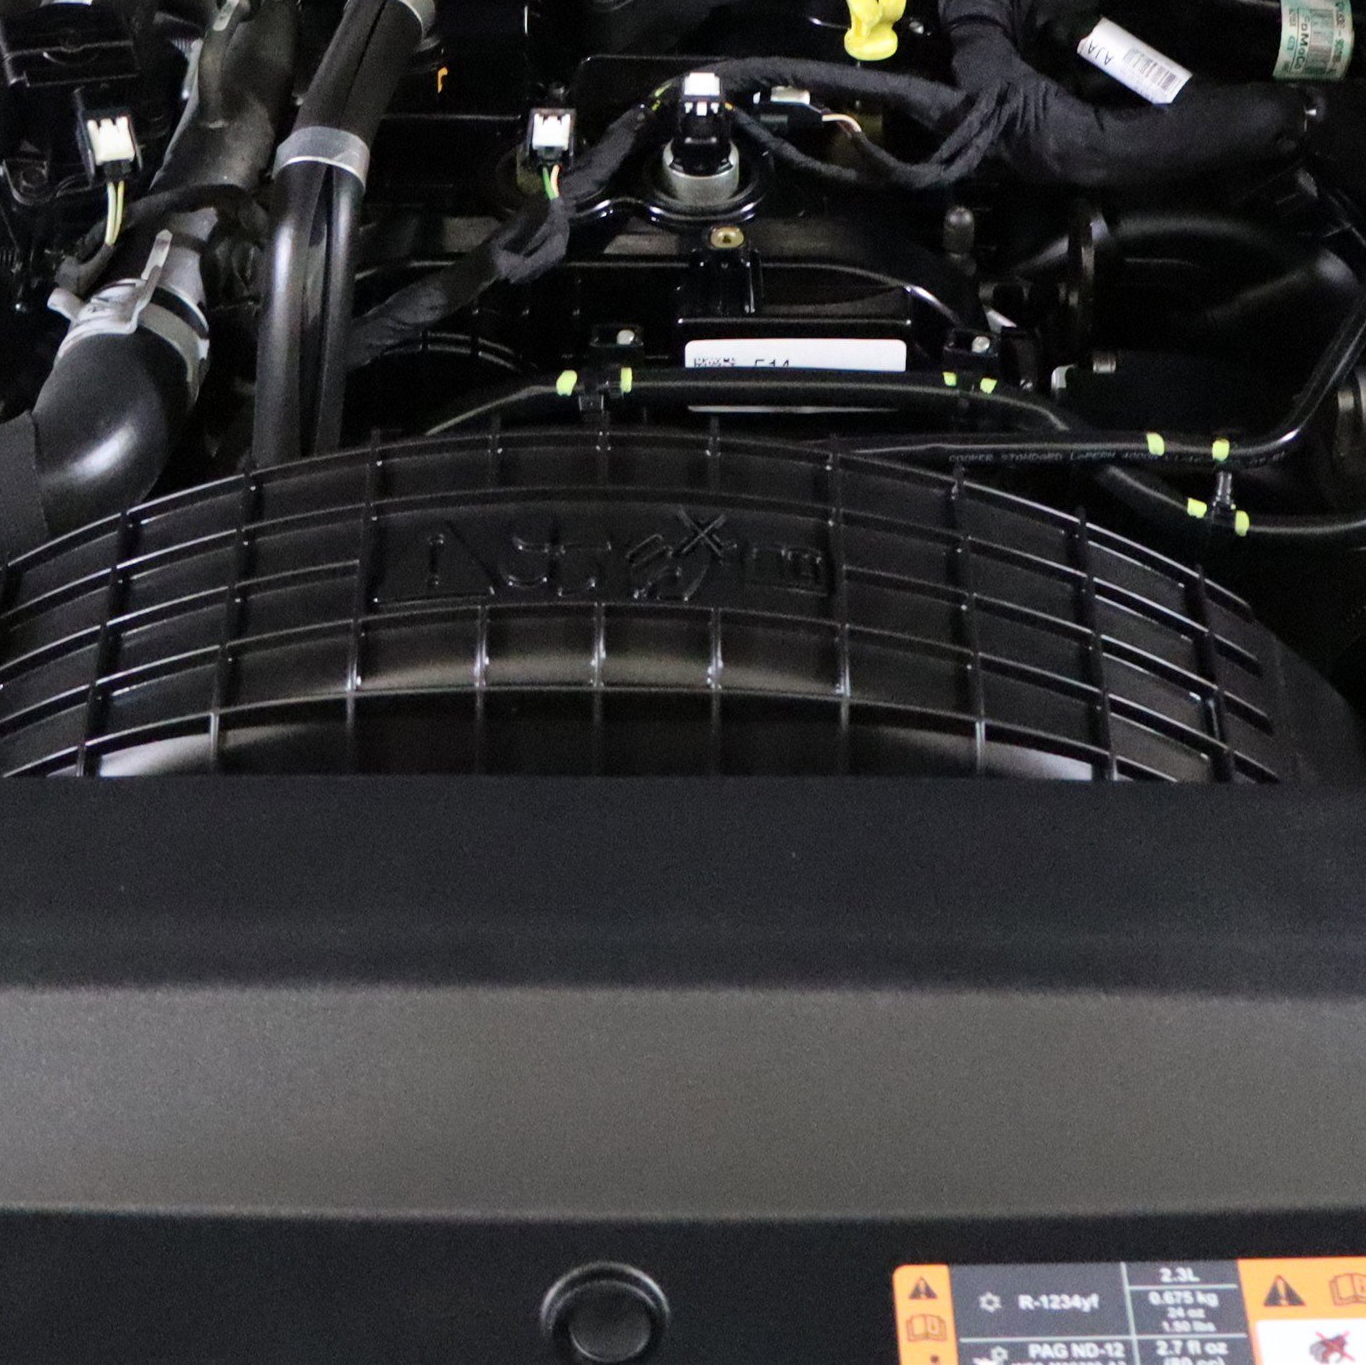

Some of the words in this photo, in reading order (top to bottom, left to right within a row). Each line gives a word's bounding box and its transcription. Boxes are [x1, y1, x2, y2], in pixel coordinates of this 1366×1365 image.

[1159, 1267, 1201, 1284] 2.3L
[1018, 1293, 1099, 1314] R-1234yf
[1148, 1290, 1195, 1306] 0.675
[1196, 1290, 1219, 1308] kg
[1028, 1342, 1069, 1360] PAG
[1070, 1341, 1125, 1359] ND-12
[1155, 1339, 1183, 1356] 2.7
[1186, 1339, 1202, 1356] fl
[1204, 1341, 1229, 1356] oz
